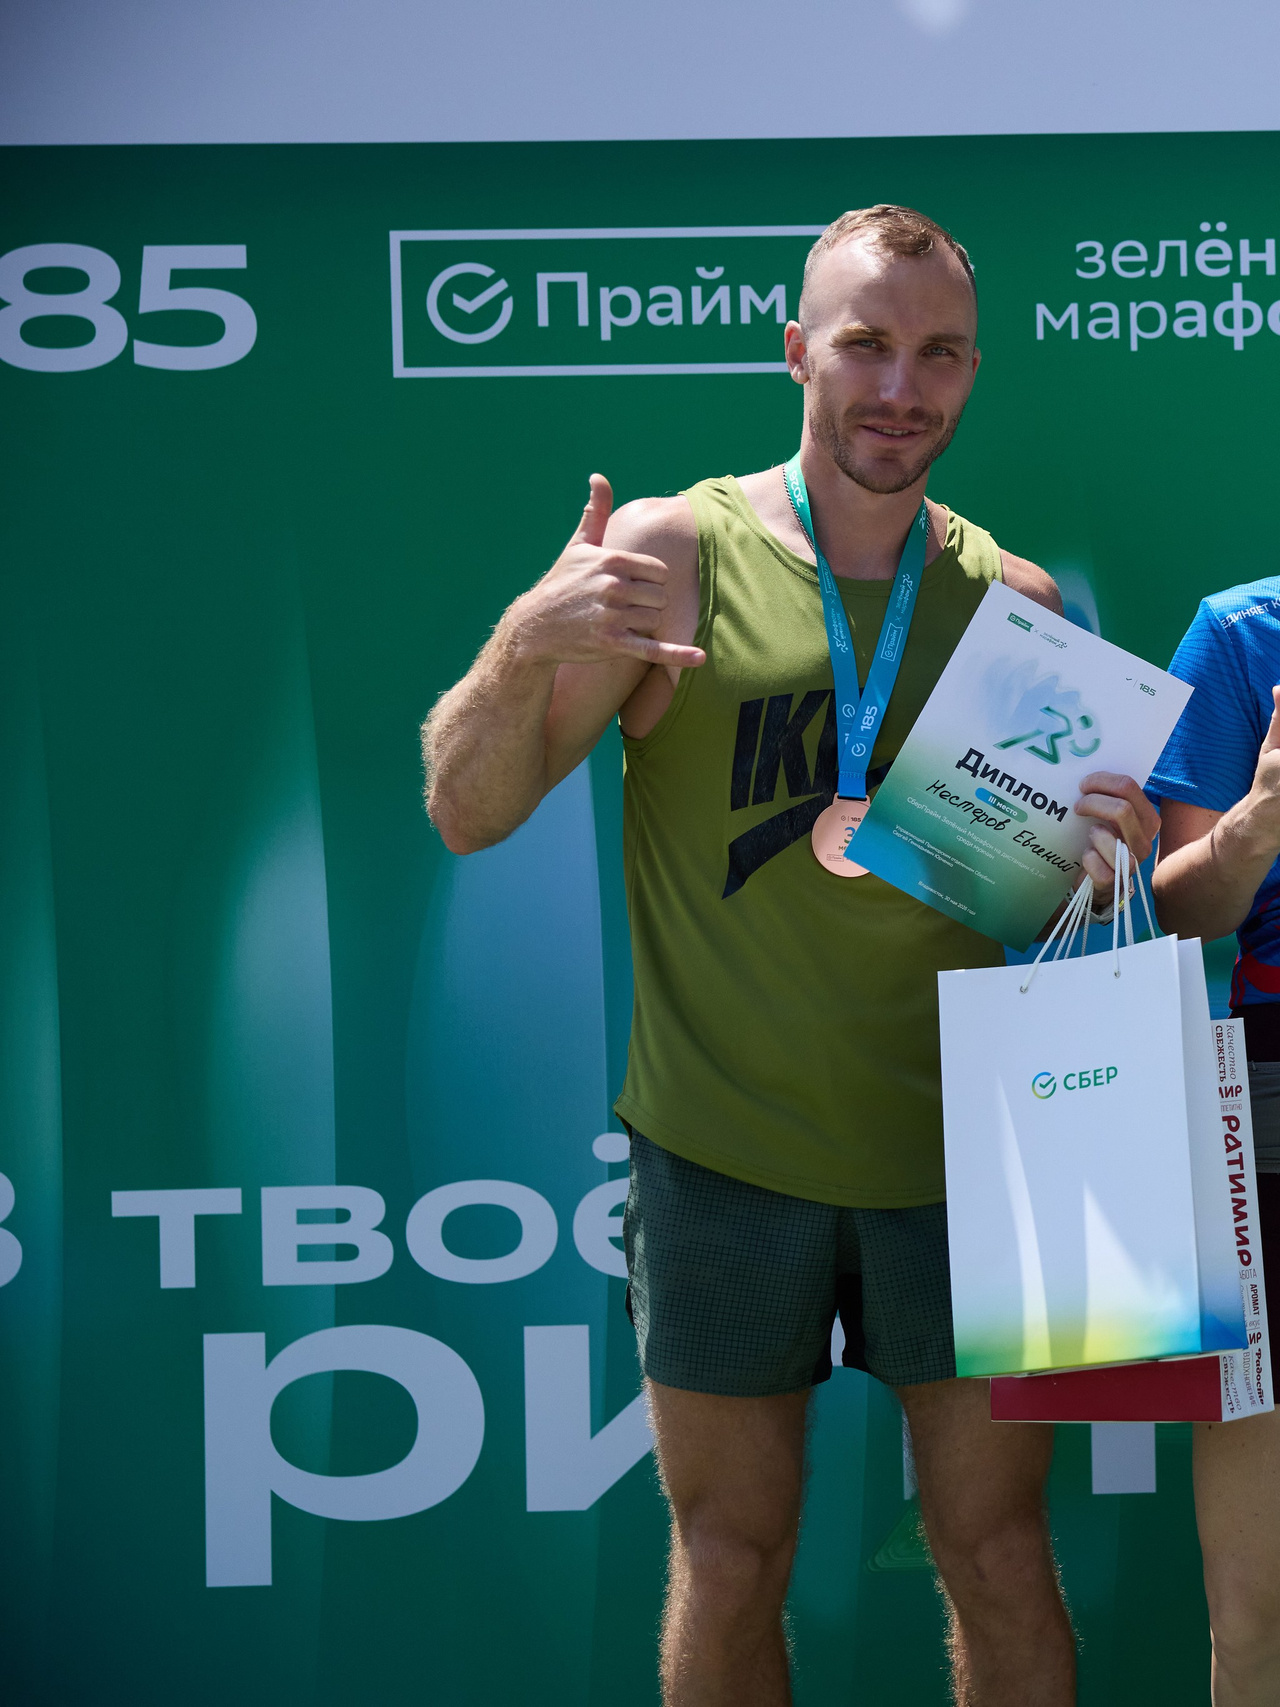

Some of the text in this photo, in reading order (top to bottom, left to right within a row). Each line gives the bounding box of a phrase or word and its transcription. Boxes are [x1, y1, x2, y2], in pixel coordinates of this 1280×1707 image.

[536, 266, 787, 341] Прайм
[1139, 682, 1157, 697] 185
[861, 705, 878, 731] 185
[926, 779, 1011, 831] Нестеров
[955, 747, 1069, 823] Диплом
[997, 801, 1018, 817] место
[1063, 1066, 1118, 1092] СБЕР
[1215, 1025, 1226, 1082] СВЕЖЕСТЬ
[1226, 1024, 1236, 1080] Качество
[1221, 1114, 1252, 1267] РАТИМИР
[1250, 1283, 1260, 1316] АРОМАТ
[1255, 1348, 1264, 1405] Радость
